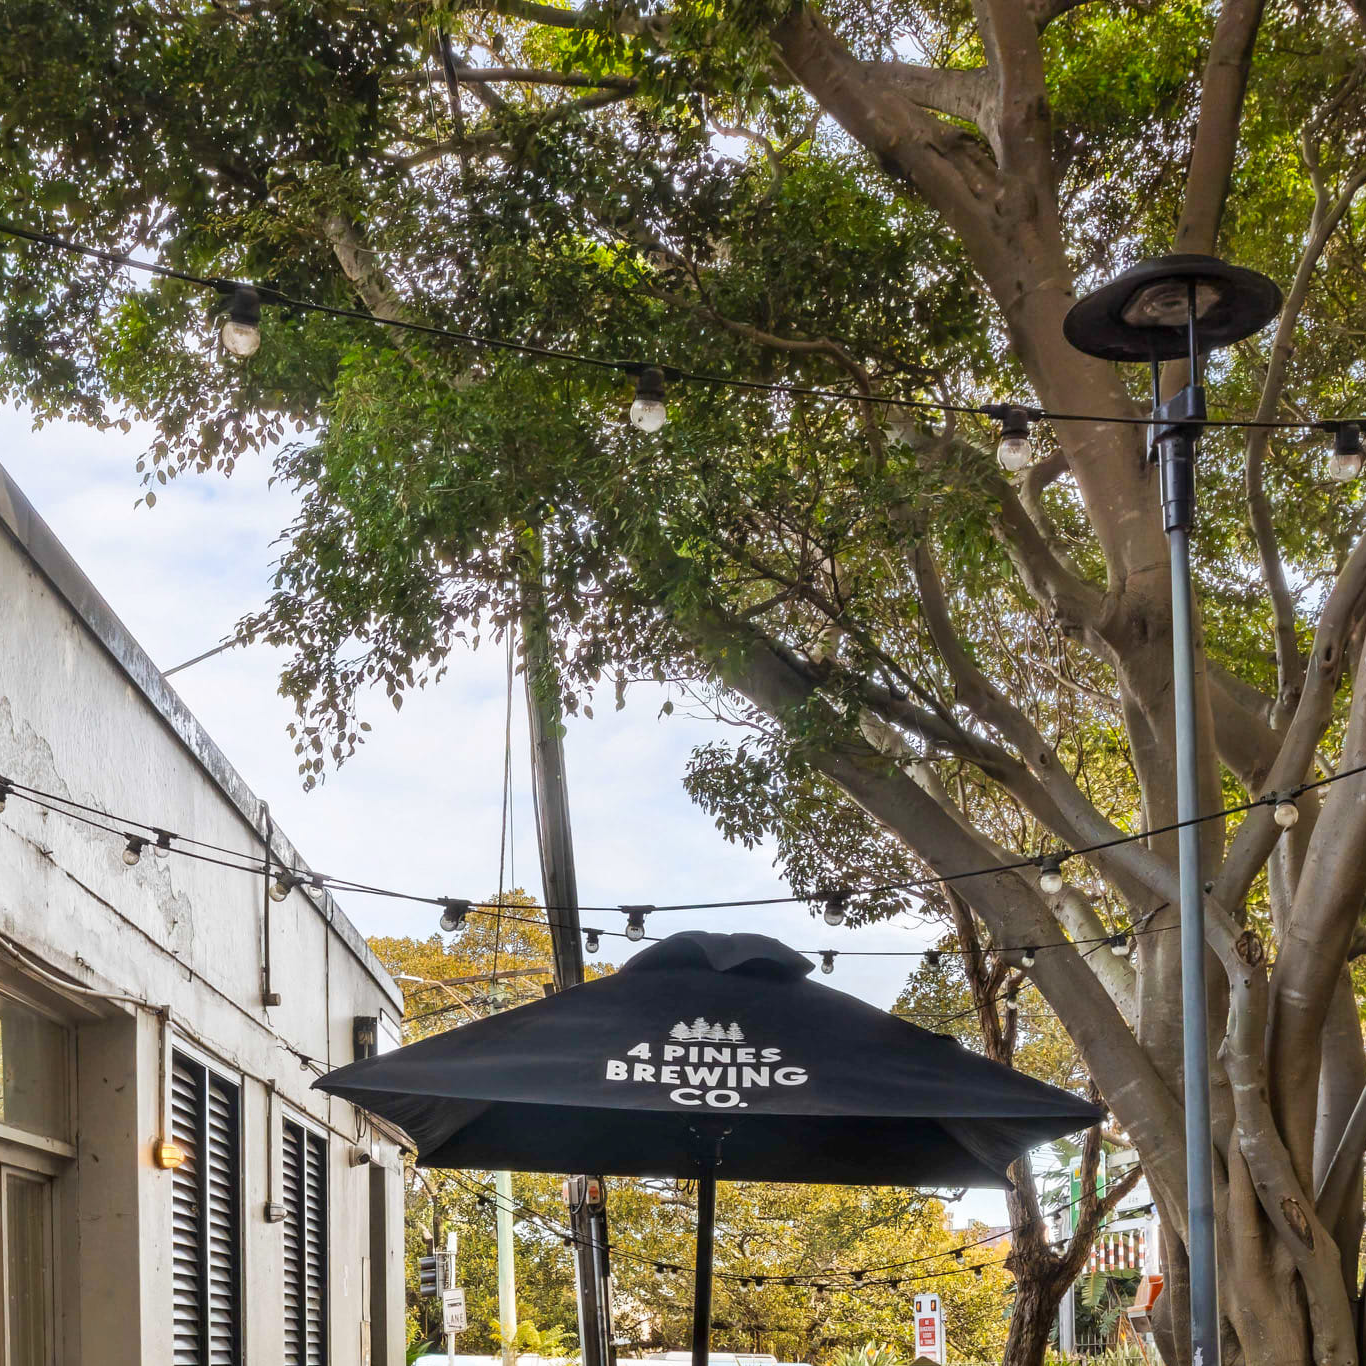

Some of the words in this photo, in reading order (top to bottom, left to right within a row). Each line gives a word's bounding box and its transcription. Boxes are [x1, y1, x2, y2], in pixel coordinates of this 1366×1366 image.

[627, 1043, 652, 1060] 4
[663, 1044, 782, 1063] PINES
[605, 1060, 809, 1088] BREWING
[670, 1088, 749, 1108] CO.
[446, 1312, 464, 1325] LANE
